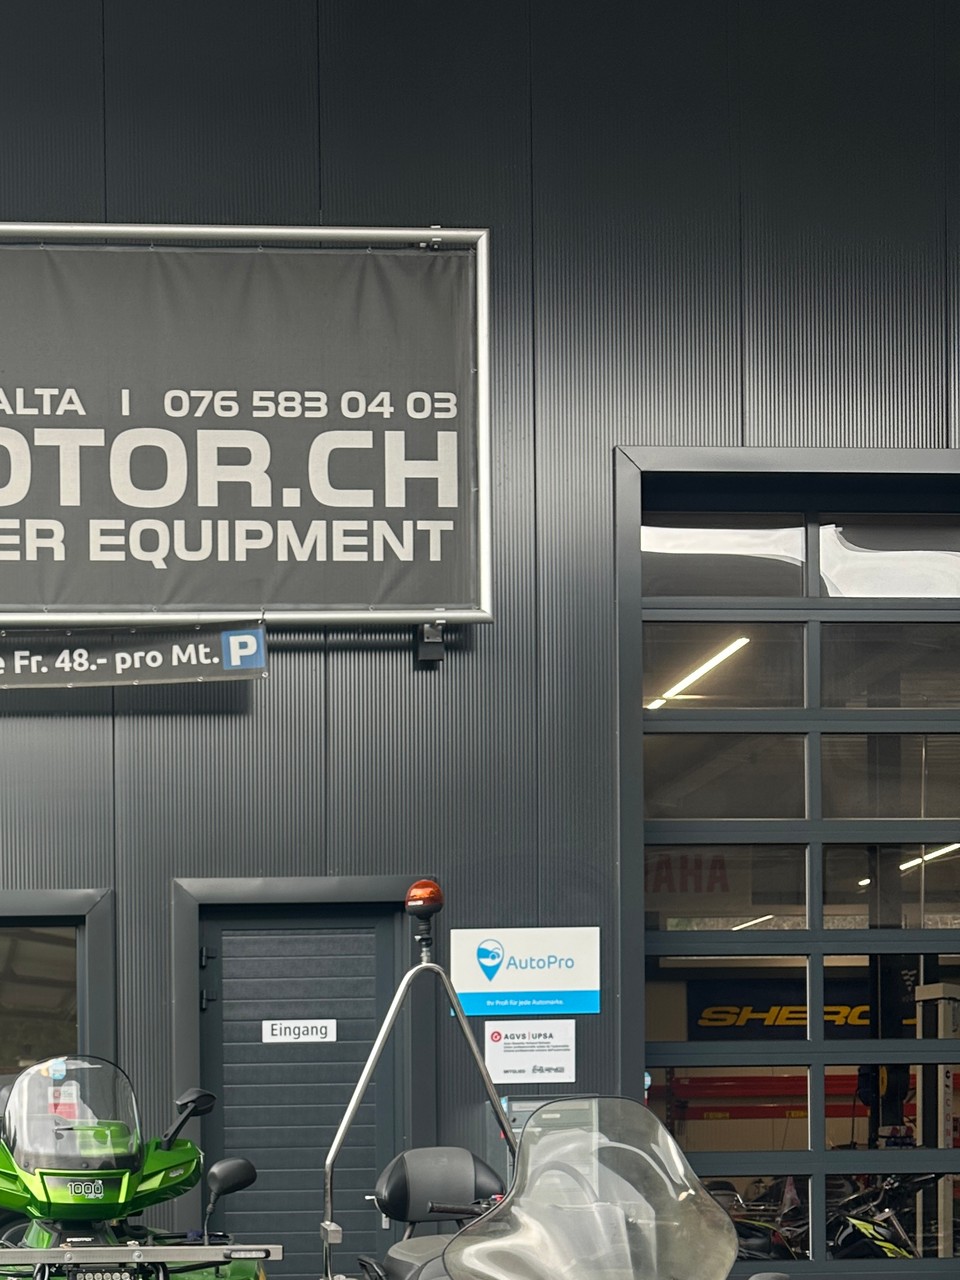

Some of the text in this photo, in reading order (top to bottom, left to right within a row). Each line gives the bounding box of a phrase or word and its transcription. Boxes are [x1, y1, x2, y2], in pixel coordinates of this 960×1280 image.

[163, 389, 240, 418] 076
[252, 390, 329, 418] 583
[340, 391, 395, 419] 04
[406, 391, 459, 419] 03
[89, 518, 454, 569] EQUIPMENT
[13, 650, 49, 674] Fr.
[54, 648, 107, 672] 48.-
[115, 650, 163, 674] pro
[171, 643, 220, 666] Mt.
[644, 854, 730, 893] AHA
[506, 954, 575, 970] AutoPro
[698, 1005, 918, 1027] SHERC
[270, 1023, 328, 1040] Eingang
